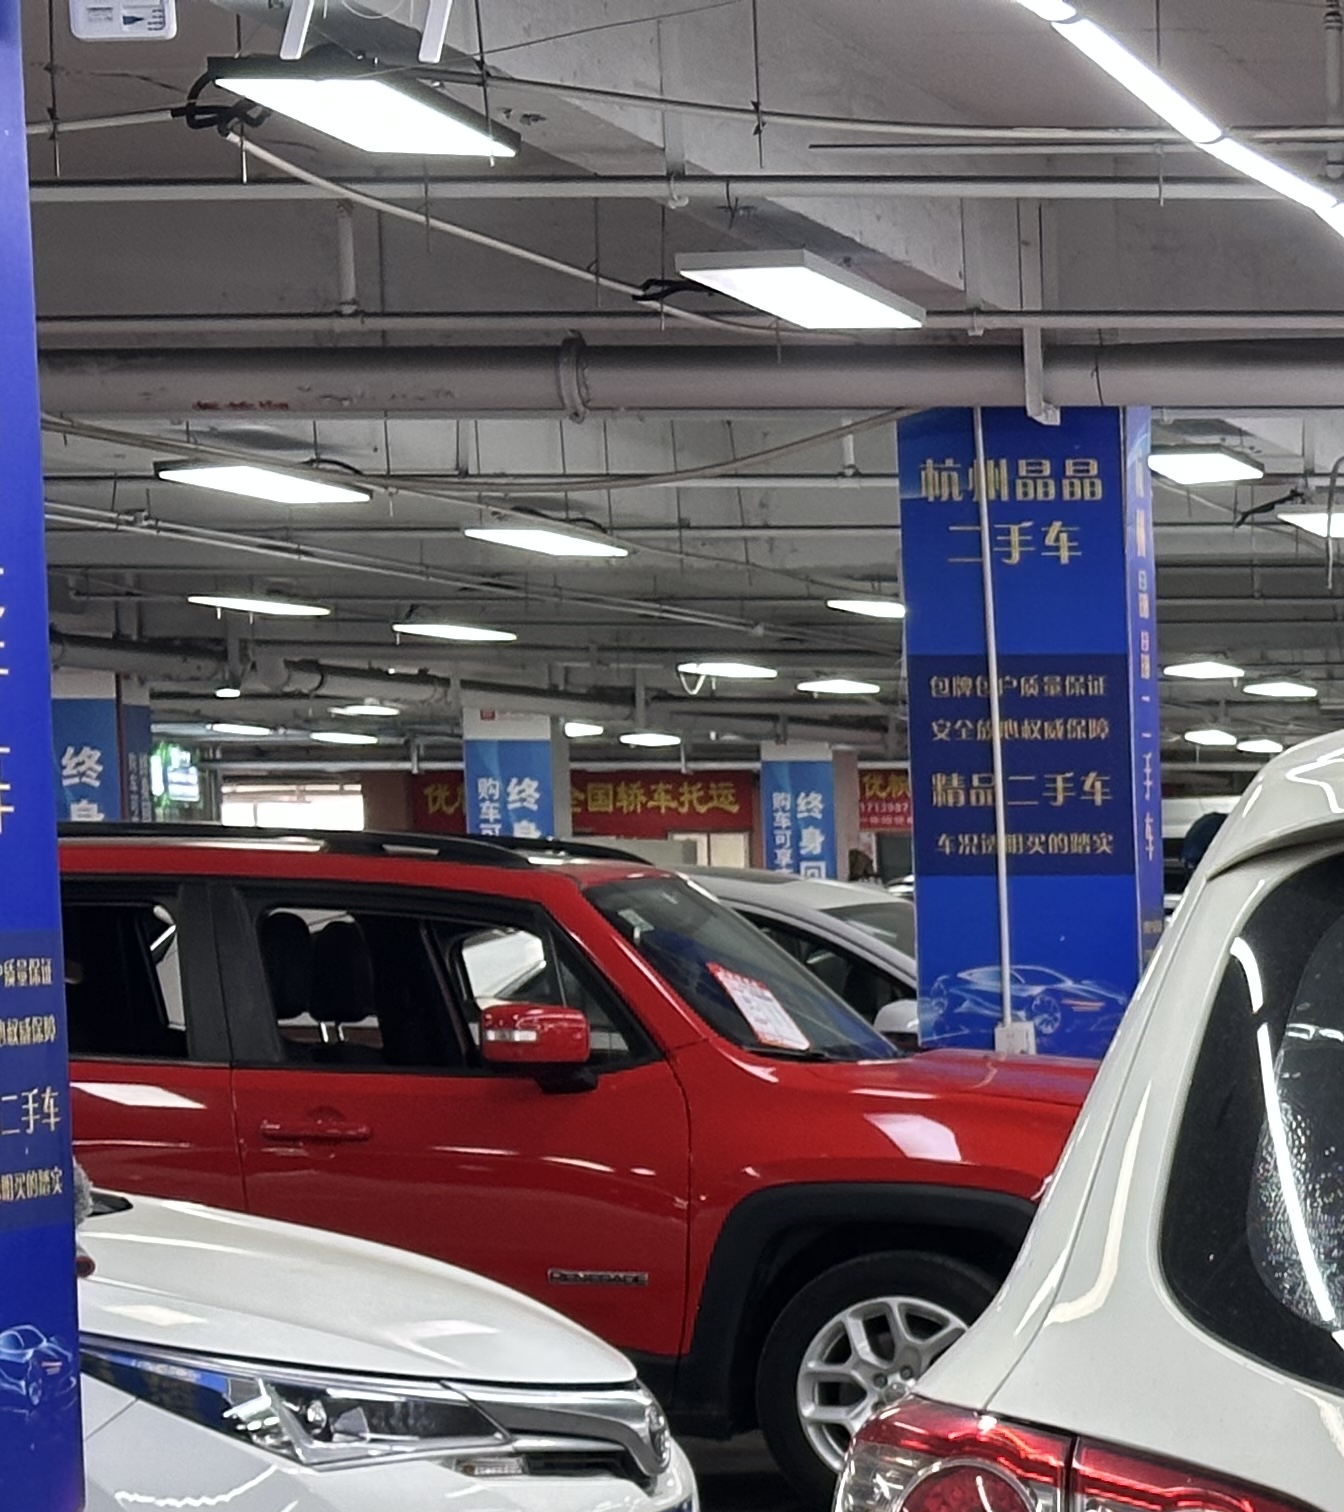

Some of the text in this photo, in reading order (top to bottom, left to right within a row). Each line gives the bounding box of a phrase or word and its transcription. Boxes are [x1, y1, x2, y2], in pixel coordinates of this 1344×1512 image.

[920, 457, 1102, 502] 杭州晶晶
[948, 520, 1082, 565] 二手车
[930, 674, 1106, 698] 包牌包户质量保证
[931, 772, 1113, 808] 精品二手车
[772, 792, 793, 872] 购车可享
[0, 957, 53, 987] 质量保证
